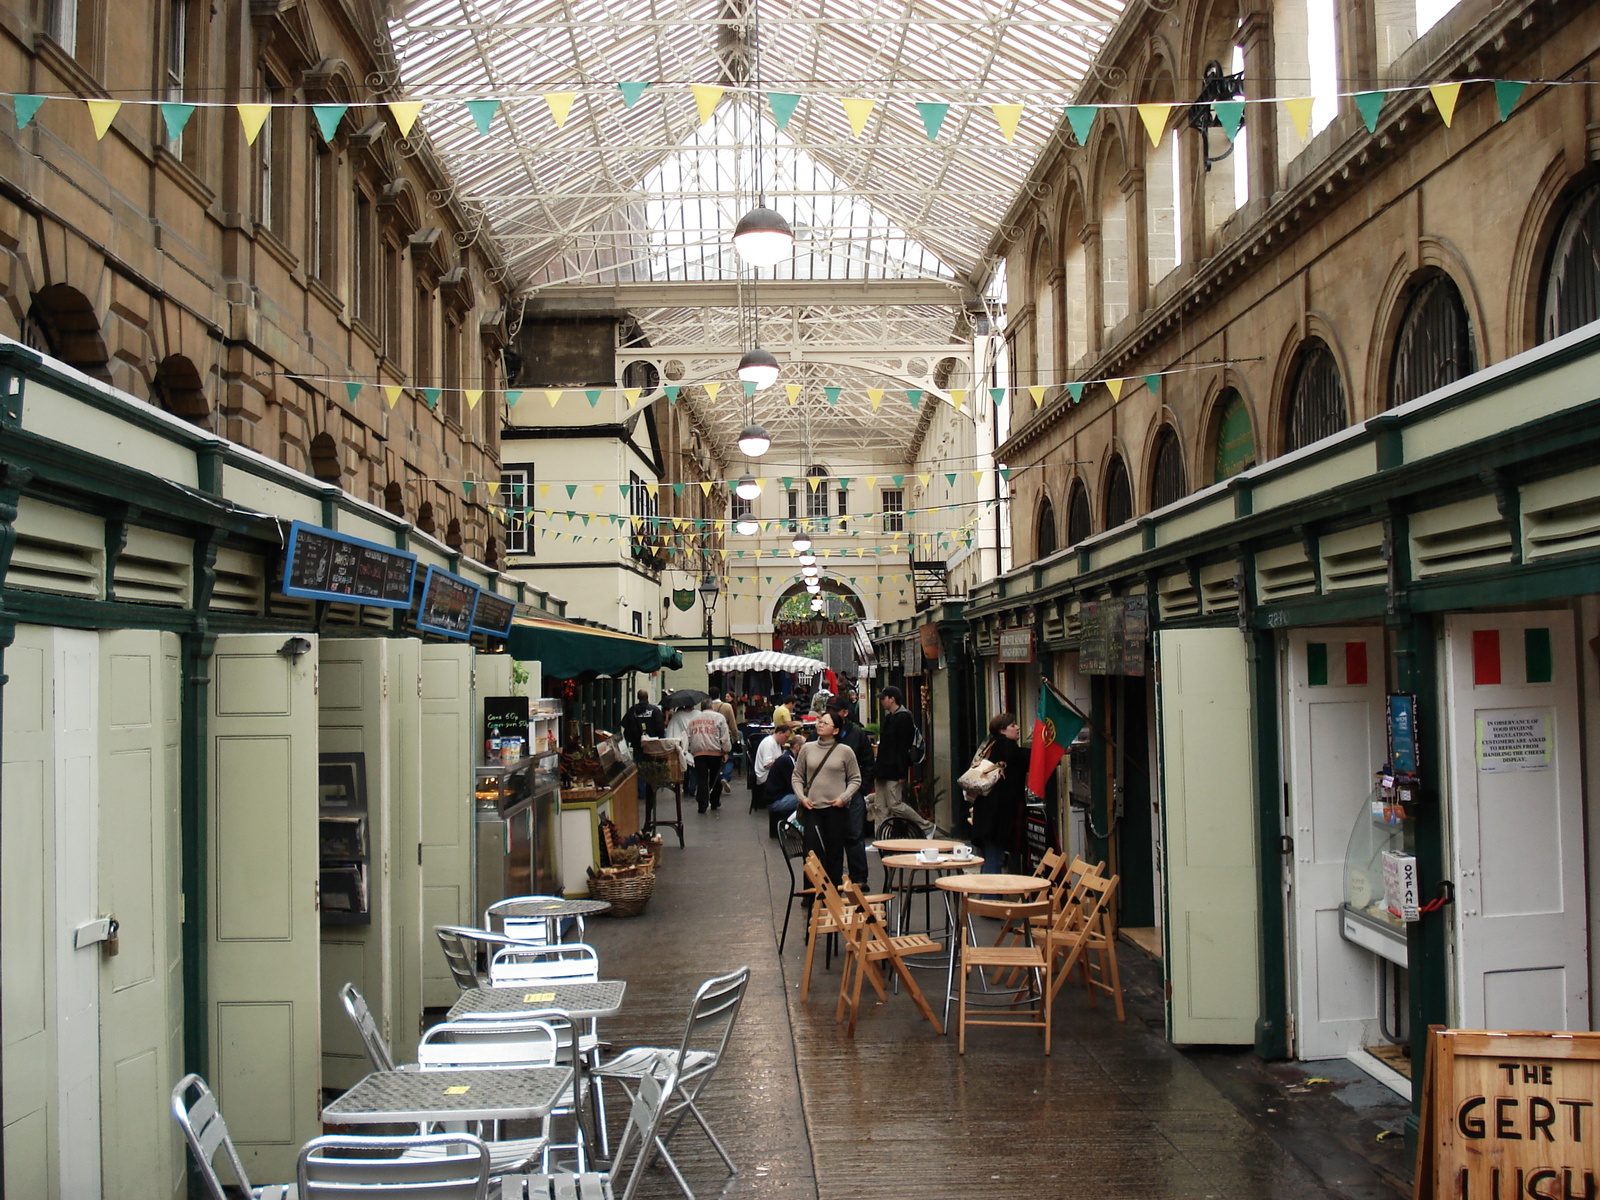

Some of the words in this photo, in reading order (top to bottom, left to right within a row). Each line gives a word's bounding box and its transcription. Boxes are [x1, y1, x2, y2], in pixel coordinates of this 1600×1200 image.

[780, 623, 818, 636] FABRIC
[826, 622, 851, 636] SALE
[505, 712, 518, 722] 60p
[1404, 864, 1413, 904] OXFAM
[1498, 1064, 1553, 1085] THE
[1456, 1095, 1594, 1142] GERT
